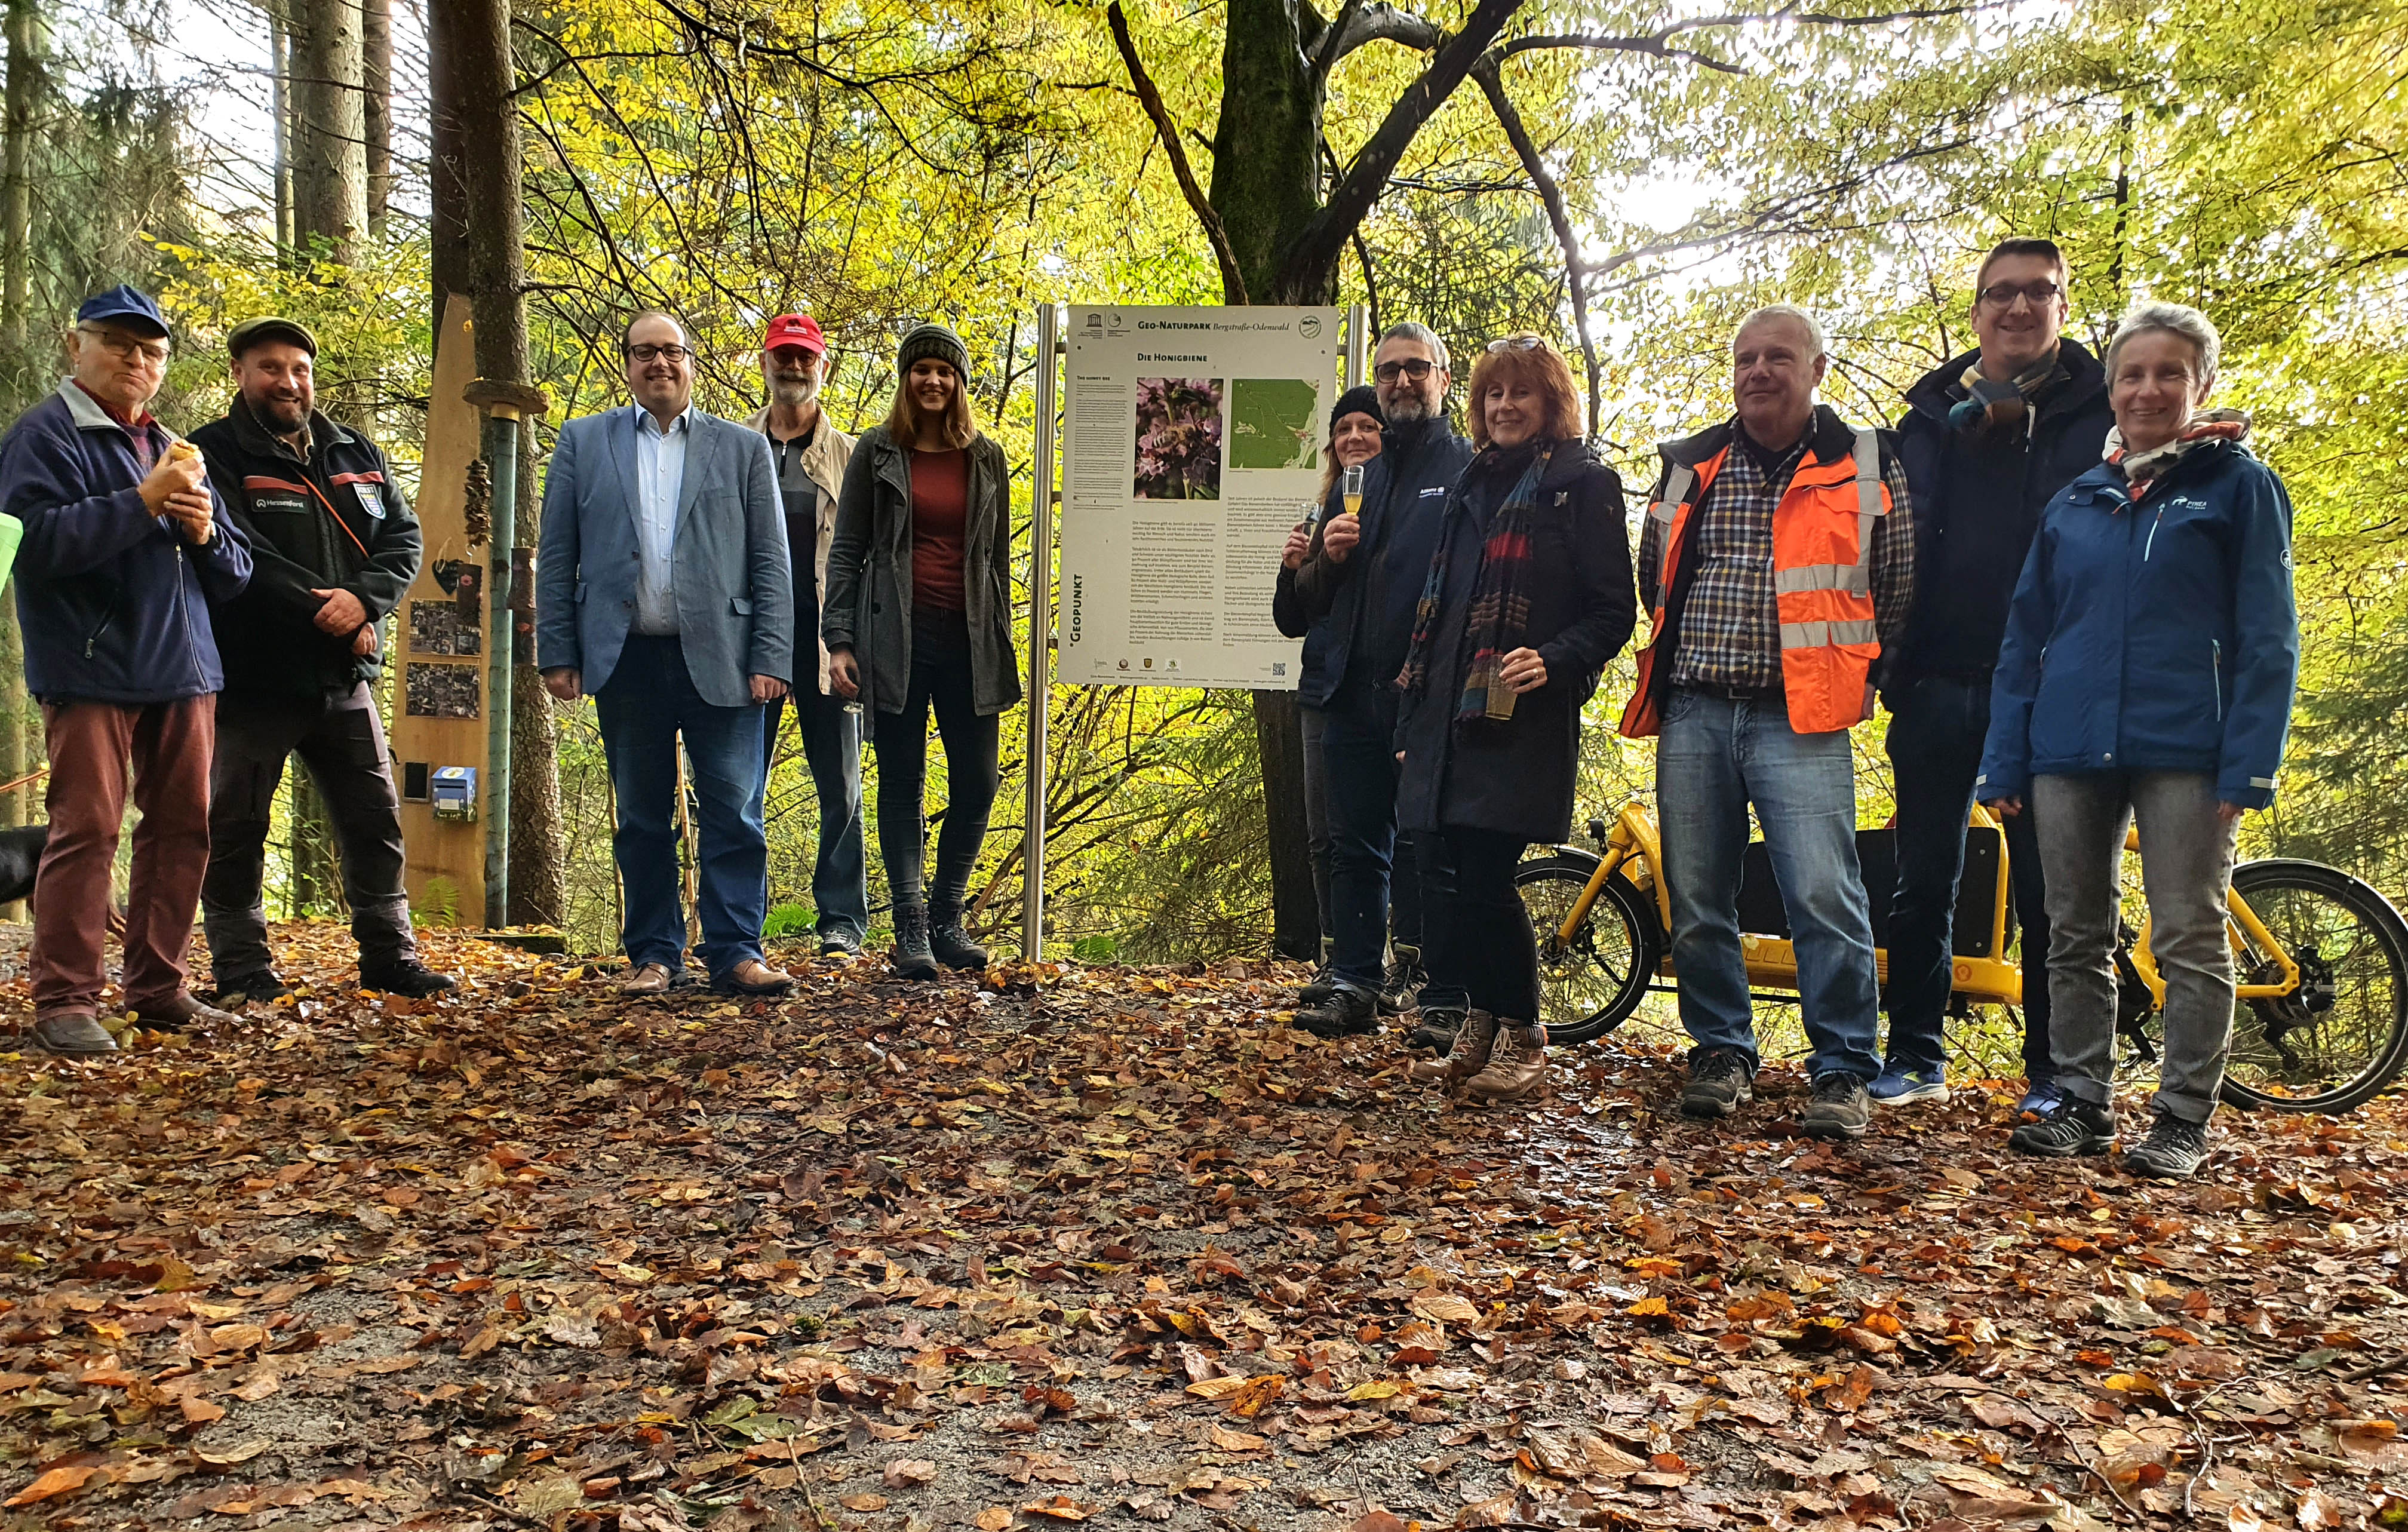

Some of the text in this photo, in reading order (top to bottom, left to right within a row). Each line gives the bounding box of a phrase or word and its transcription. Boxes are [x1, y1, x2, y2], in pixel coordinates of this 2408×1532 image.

[1138, 321, 1290, 332] GEO-NATURPARK Bergstraße-Odenwald
[1137, 353, 1208, 362] DIE HONIGBIENE
[1070, 574, 1083, 642] GEOPUNKT
